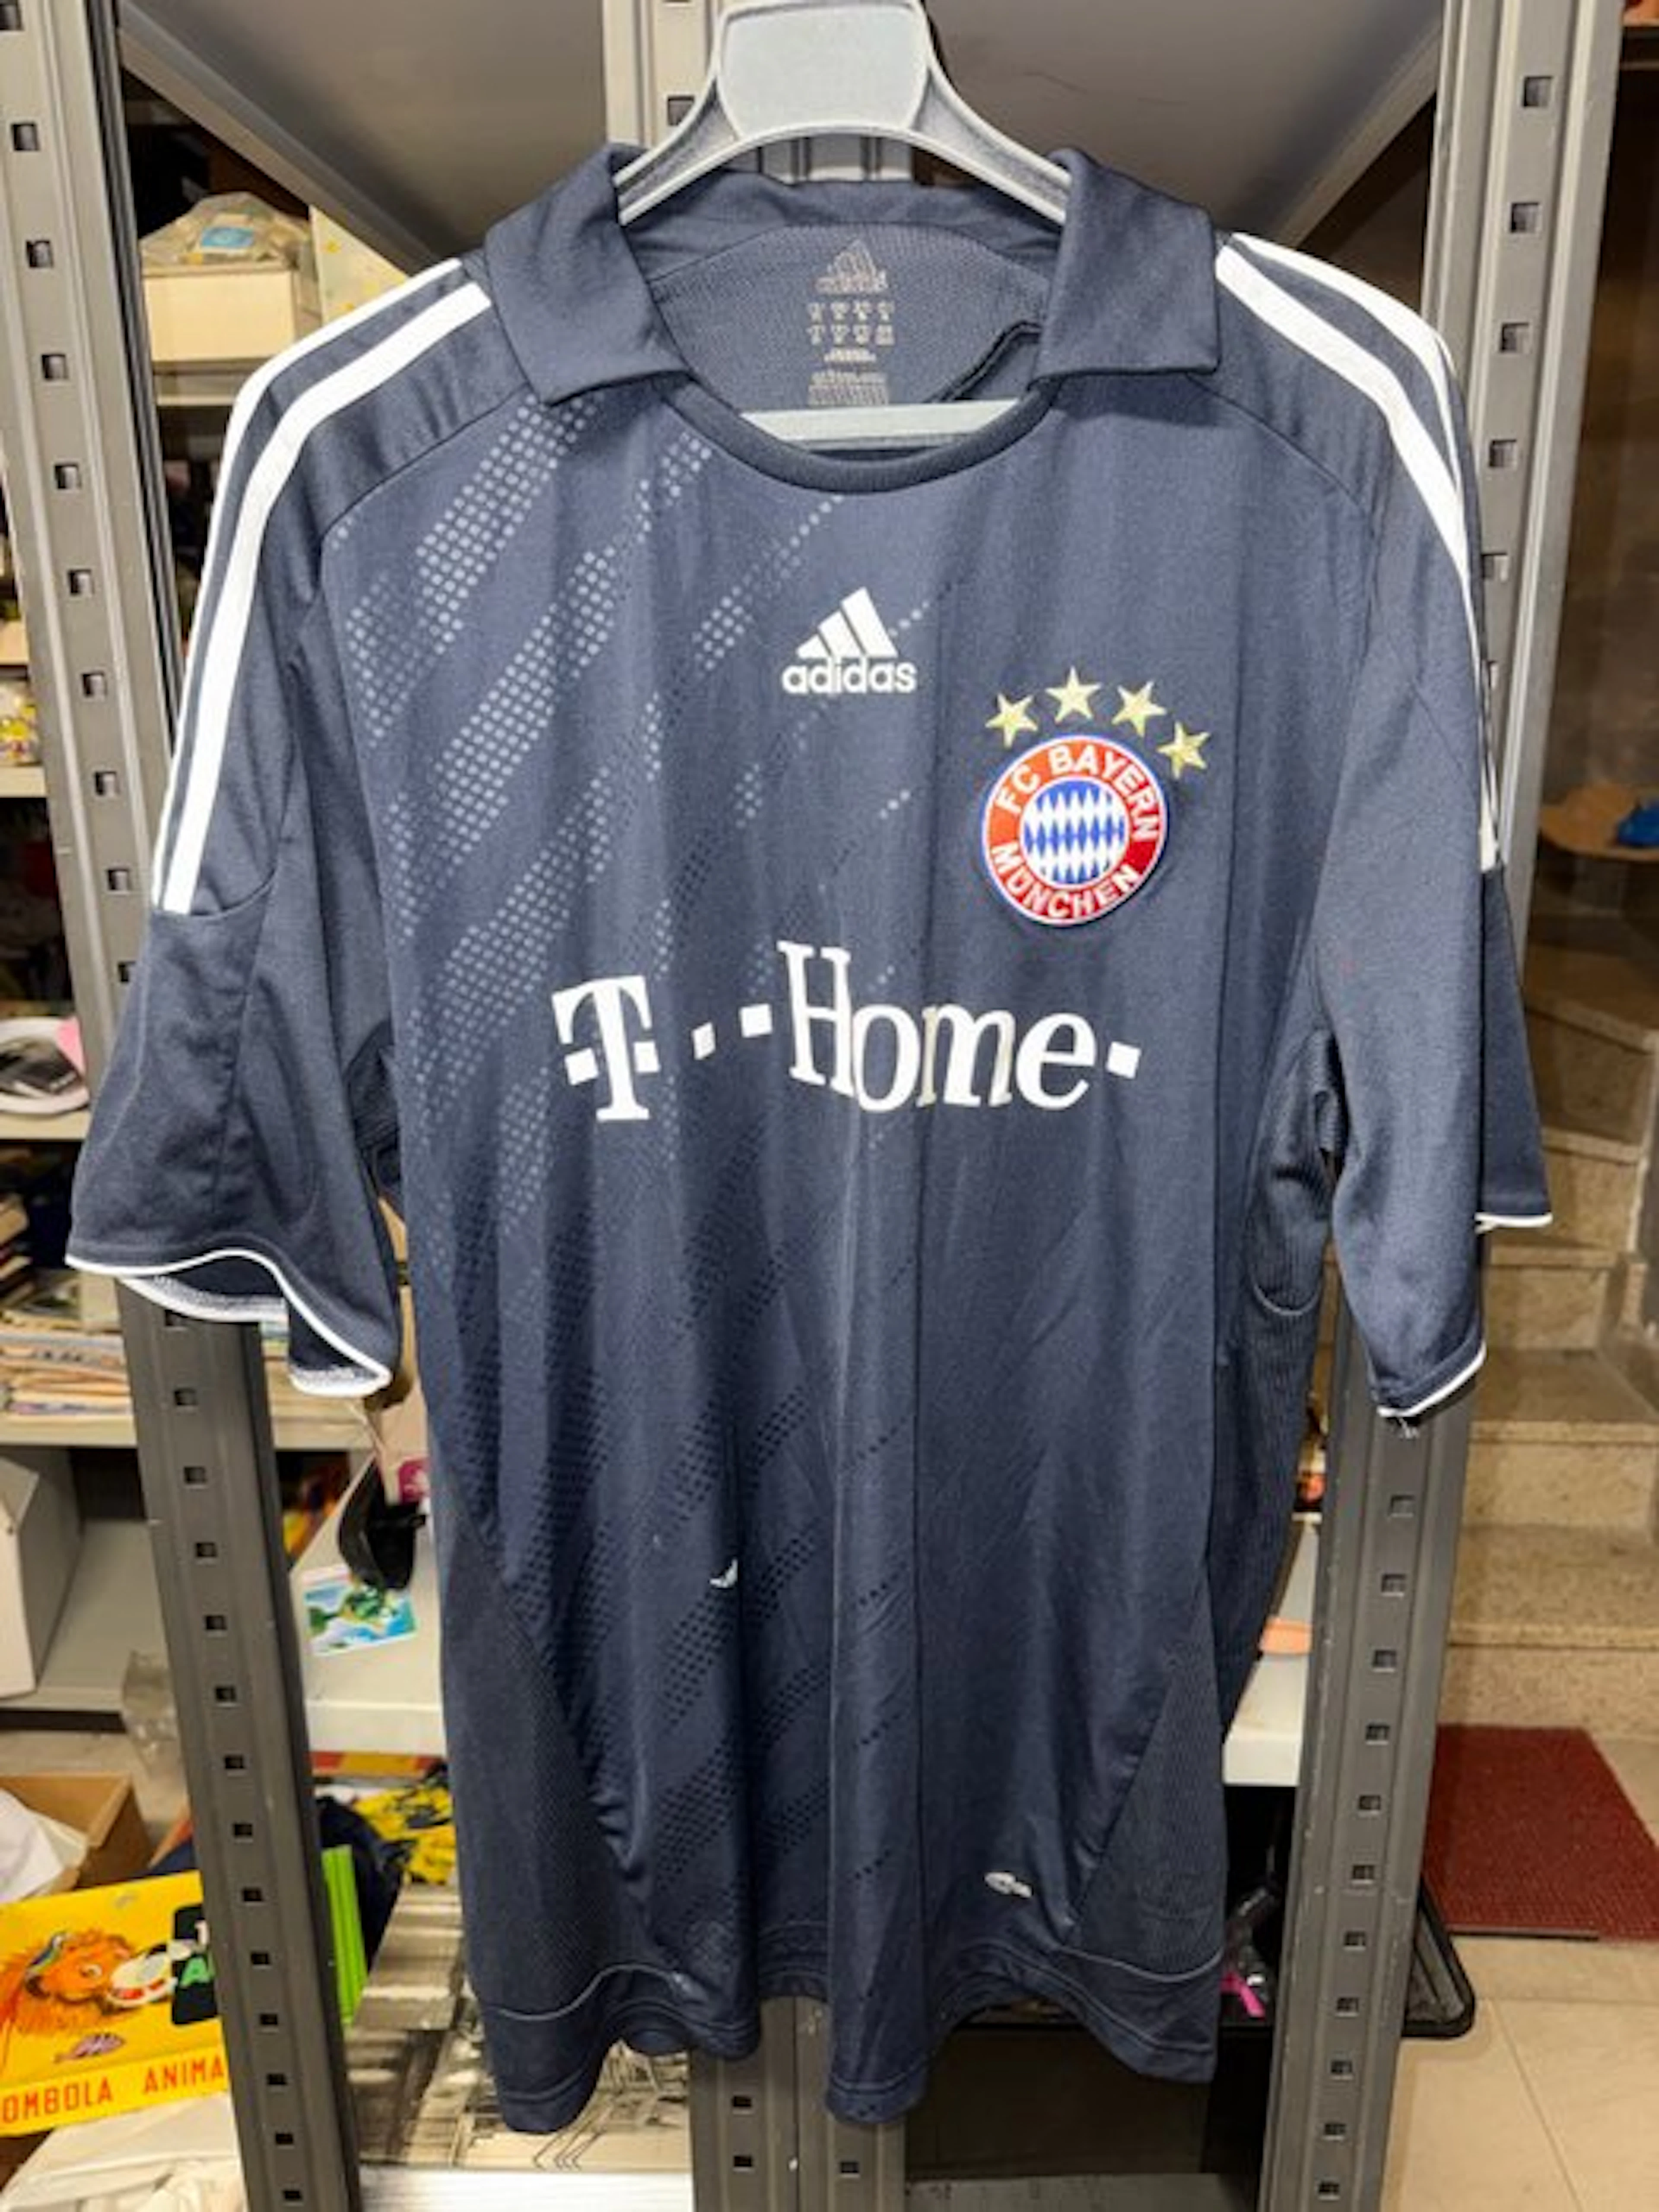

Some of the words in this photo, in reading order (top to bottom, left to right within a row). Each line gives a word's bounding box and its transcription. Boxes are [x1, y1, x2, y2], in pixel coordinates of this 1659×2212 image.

[782, 656, 918, 695] adidas
[995, 763, 1042, 814] FC
[1048, 744, 1160, 842] BAYERN
